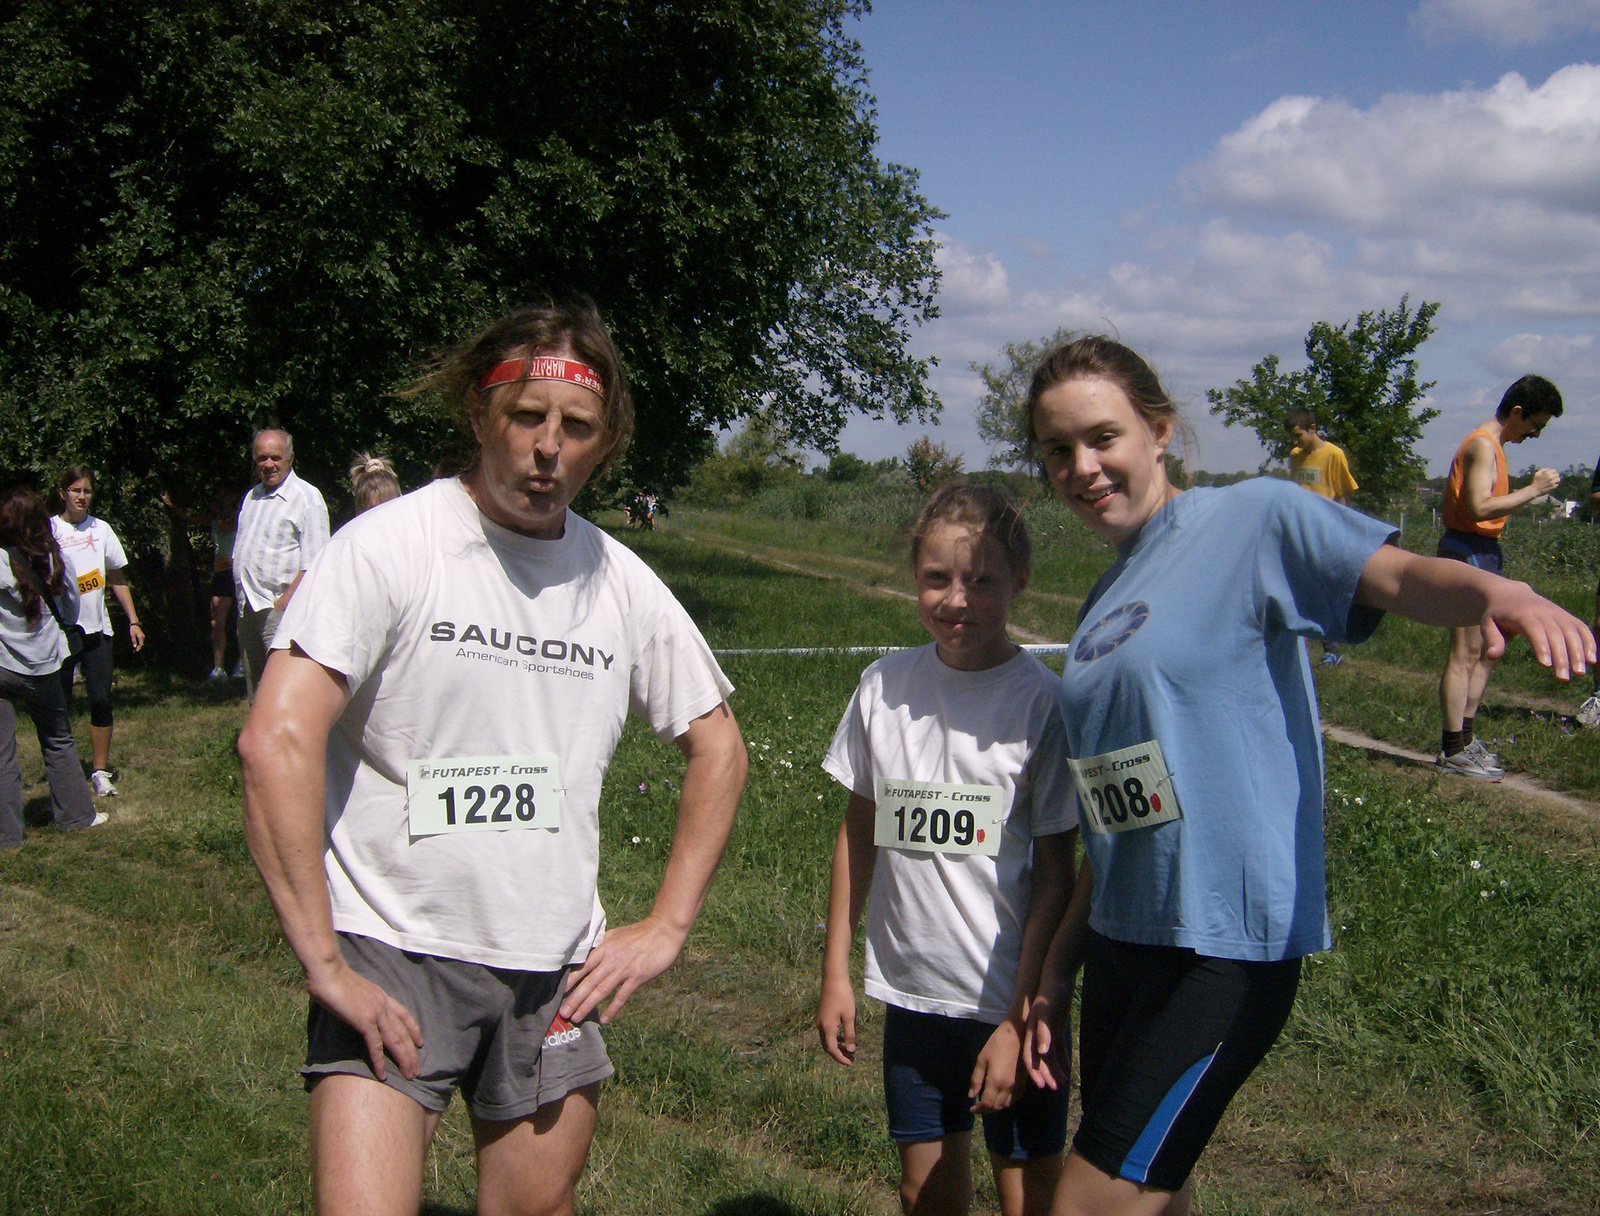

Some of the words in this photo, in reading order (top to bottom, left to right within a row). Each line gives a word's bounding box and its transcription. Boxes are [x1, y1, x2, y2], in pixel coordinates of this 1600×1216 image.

[529, 359, 566, 378] MARATO
[78, 577, 99, 593] 350
[430, 621, 614, 671] SAUCONY
[455, 647, 519, 667] American
[522, 660, 594, 681] Sportshoes
[432, 766, 500, 779] FUTAPEST
[510, 765, 548, 775] Cross
[1111, 754, 1151, 771] Cross
[438, 783, 536, 825] 1228
[891, 788, 942, 800] FUTAPEST
[951, 791, 991, 803] Cross
[894, 806, 975, 846] 1209
